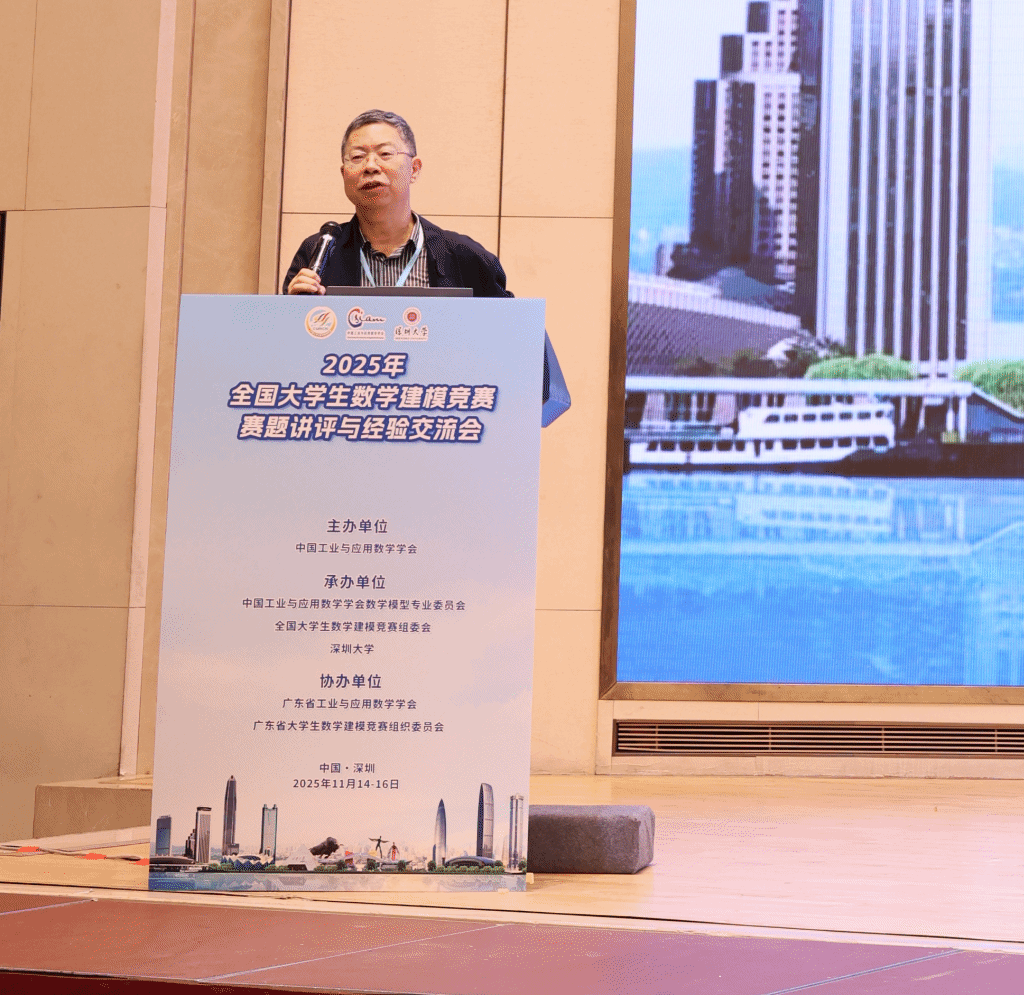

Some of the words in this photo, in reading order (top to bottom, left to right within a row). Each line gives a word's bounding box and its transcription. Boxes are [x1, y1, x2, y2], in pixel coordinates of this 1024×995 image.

[322, 353, 407, 378] 2025年
[229, 383, 496, 410] 全国大学生数学建模竞赛
[239, 414, 483, 442] 赛题讲评与经验交流会
[327, 519, 388, 533] 主办单位
[295, 542, 417, 554] 中国工业与应用数学学会
[324, 574, 386, 589] 承办单位
[242, 598, 465, 611] 中国工业与应用数学学会数学模型专业委员会
[275, 621, 431, 633] 全国大学生数学建模竞赛组委会
[330, 643, 374, 654] 深圳大学
[320, 673, 382, 688] 协办单位
[282, 698, 417, 710] 广东省工业与应用数学学会
[253, 720, 444, 732] 广东省大学生数学建模竞赛组织委员会
[293, 778, 399, 789] 2025年11月14-16日
